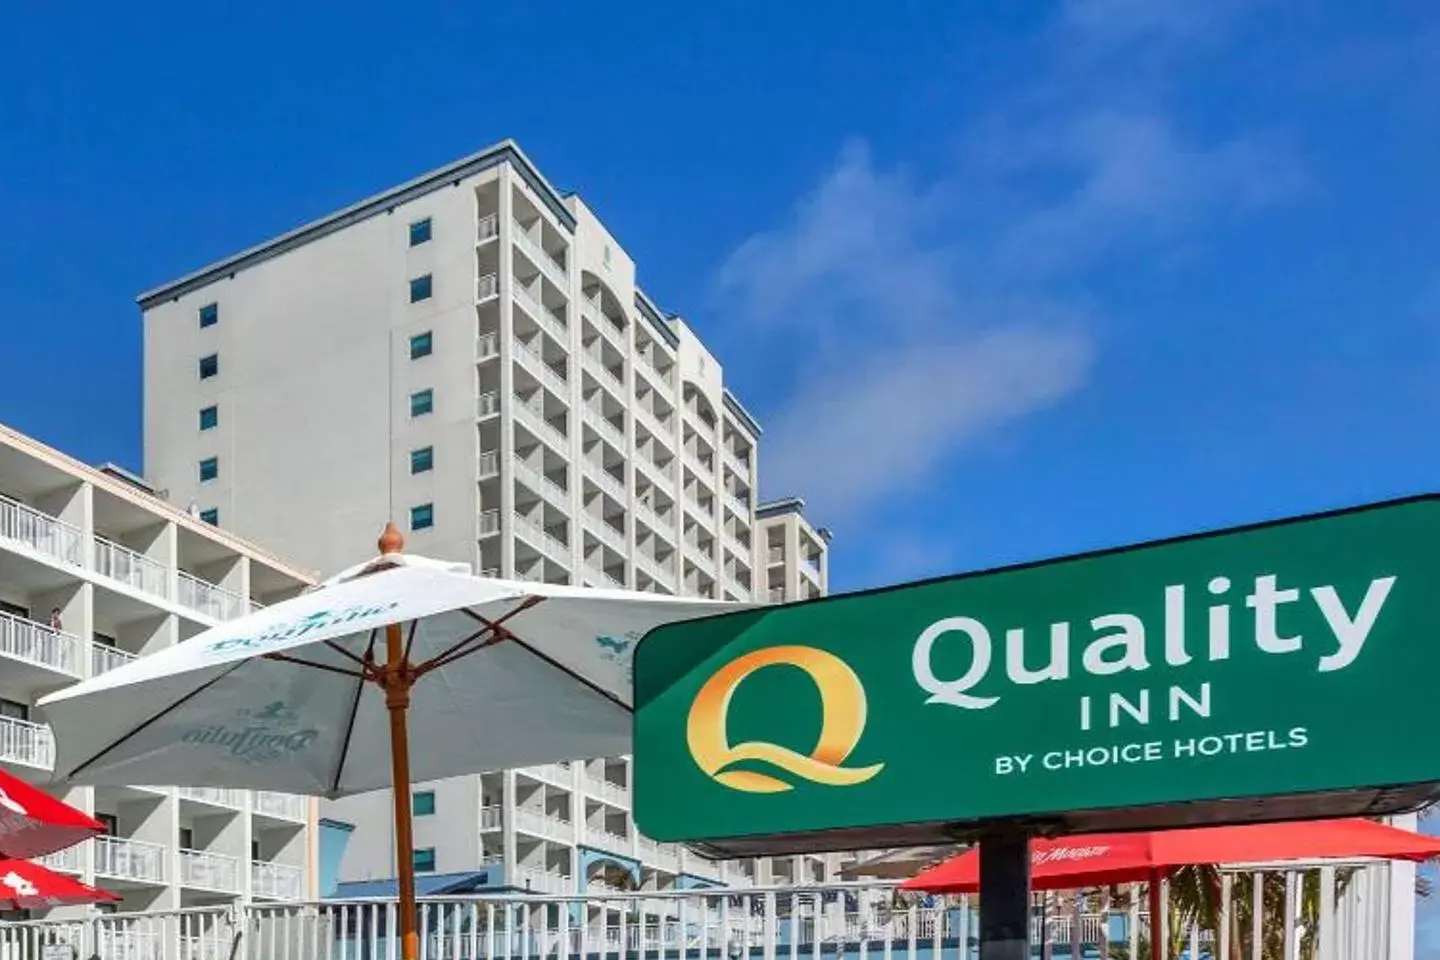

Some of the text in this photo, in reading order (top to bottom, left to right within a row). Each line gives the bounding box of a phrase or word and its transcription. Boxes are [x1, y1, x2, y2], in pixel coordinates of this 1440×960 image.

[910, 574, 1398, 709] Quality
[1079, 682, 1212, 731] INN
[994, 726, 1309, 776] BY CHOICE HOTELS
